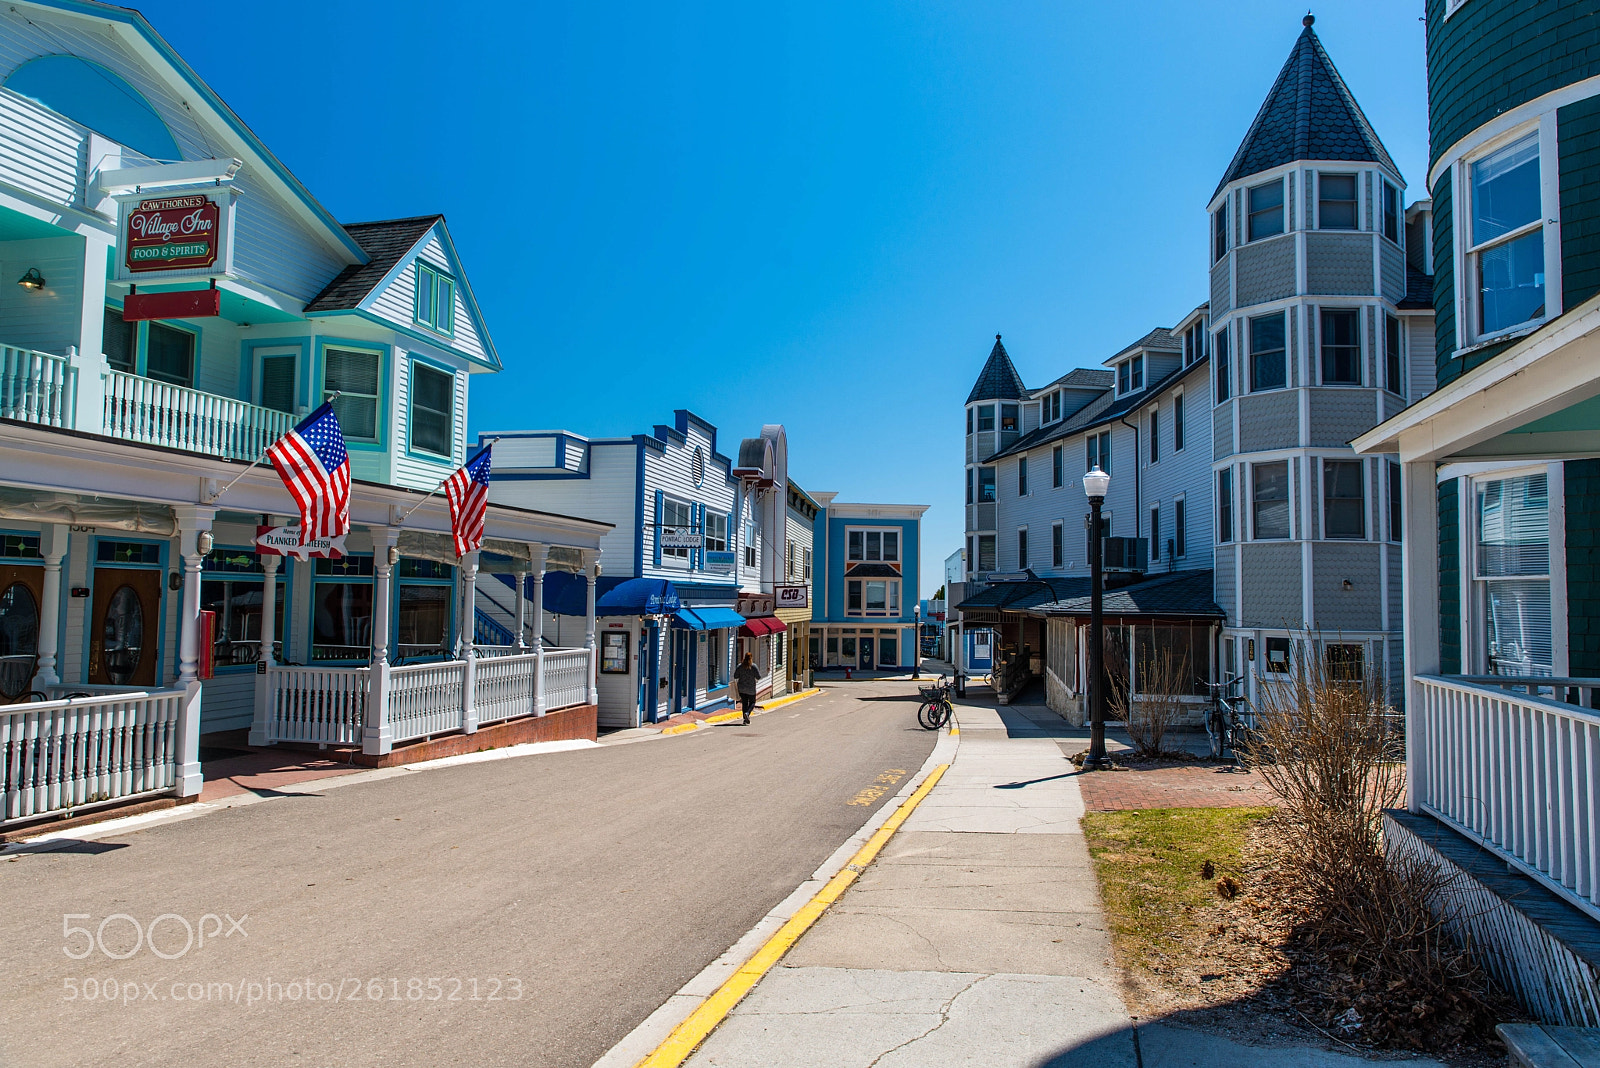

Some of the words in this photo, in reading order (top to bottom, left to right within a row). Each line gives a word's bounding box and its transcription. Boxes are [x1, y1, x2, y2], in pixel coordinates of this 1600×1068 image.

[131, 213, 179, 241] Village
[180, 208, 213, 234] Inn
[134, 249, 159, 259] FOOD
[161, 247, 168, 257] &
[169, 245, 205, 256] SPIRITS
[266, 535, 297, 546] PLANKED
[781, 588, 799, 600] CSB
